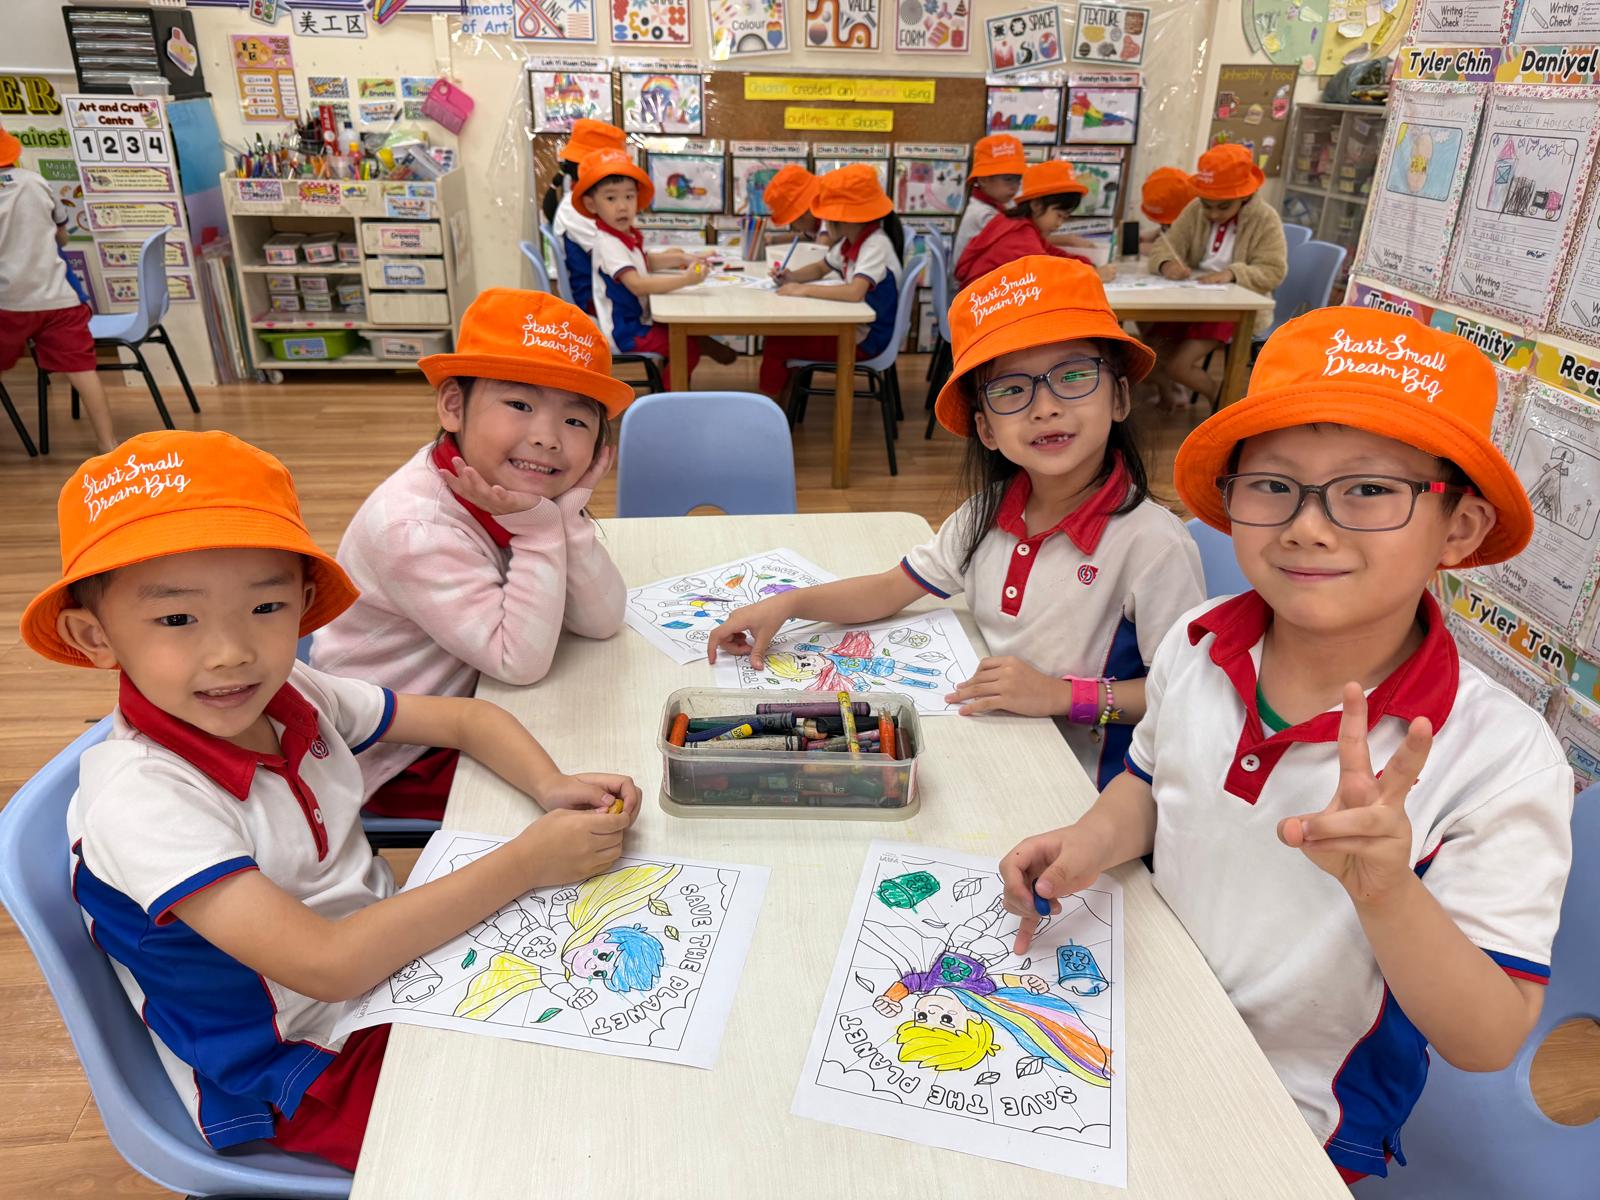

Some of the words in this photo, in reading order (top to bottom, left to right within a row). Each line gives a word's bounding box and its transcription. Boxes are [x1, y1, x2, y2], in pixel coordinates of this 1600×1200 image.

[470, 4, 513, 15] ments
[1083, 7, 1121, 28] TEXTURE
[1441, 5, 1463, 18] Writing
[1549, 1, 1579, 15] Writing
[299, 14, 364, 34] 美工区
[462, 19, 477, 33] of
[484, 20, 509, 33] Art
[732, 20, 765, 30] Colour
[1029, 11, 1056, 32] SPACE
[1441, 18, 1459, 27] Check
[1549, 15, 1572, 27] Check
[899, 29, 926, 46] FORM
[1409, 51, 1452, 76] Tyler
[1455, 50, 1493, 73] Chin
[1521, 48, 1597, 79] Daniyal
[792, 83, 832, 96] created
[837, 87, 853, 96] an
[902, 88, 931, 101] using
[78, 102, 97, 112] Art
[98, 102, 118, 112] and
[120, 102, 149, 113] Craft
[98, 115, 134, 125] Centre
[786, 112, 829, 126] outlines
[836, 112, 849, 126] of
[853, 116, 888, 128] shapes
[12, 126, 67, 147] ainst
[82, 136, 93, 154] 1
[103, 136, 119, 154] 2
[125, 136, 140, 154] 3
[149, 136, 163, 154] 4
[390, 232, 420, 240] Drawing
[1383, 247, 1403, 264] Writing
[969, 286, 1001, 312] Start
[1000, 272, 1037, 296] Small
[1475, 273, 1501, 290] Writing
[1475, 285, 1496, 299] Check
[972, 297, 1013, 327] Dream
[1011, 286, 1043, 307] Big
[522, 313, 560, 335] Start
[559, 321, 594, 348] Small
[1456, 319, 1514, 362] Trinity
[522, 330, 570, 353] Dream
[568, 342, 594, 367] Big
[1325, 328, 1389, 356] Start
[1386, 334, 1448, 372] Small
[1322, 354, 1400, 380] Dream
[1400, 365, 1443, 403] Big
[1560, 353, 1600, 395] Rea
[82, 466, 126, 504] Start
[124, 451, 184, 482] Small
[88, 484, 145, 524] Dream
[142, 473, 192, 498] Big
[1501, 574, 1522, 592] Check
[1502, 563, 1528, 588] Writing
[1469, 593, 1517, 637] Tyler
[1527, 629, 1564, 668] Tan
[680, 883, 713, 928] SAVE
[679, 933, 712, 973] THE
[591, 975, 689, 1035] PLANET
[839, 1014, 921, 1094] PLANET
[927, 1084, 989, 1115] THE
[1000, 1085, 1078, 1117] SAVE
